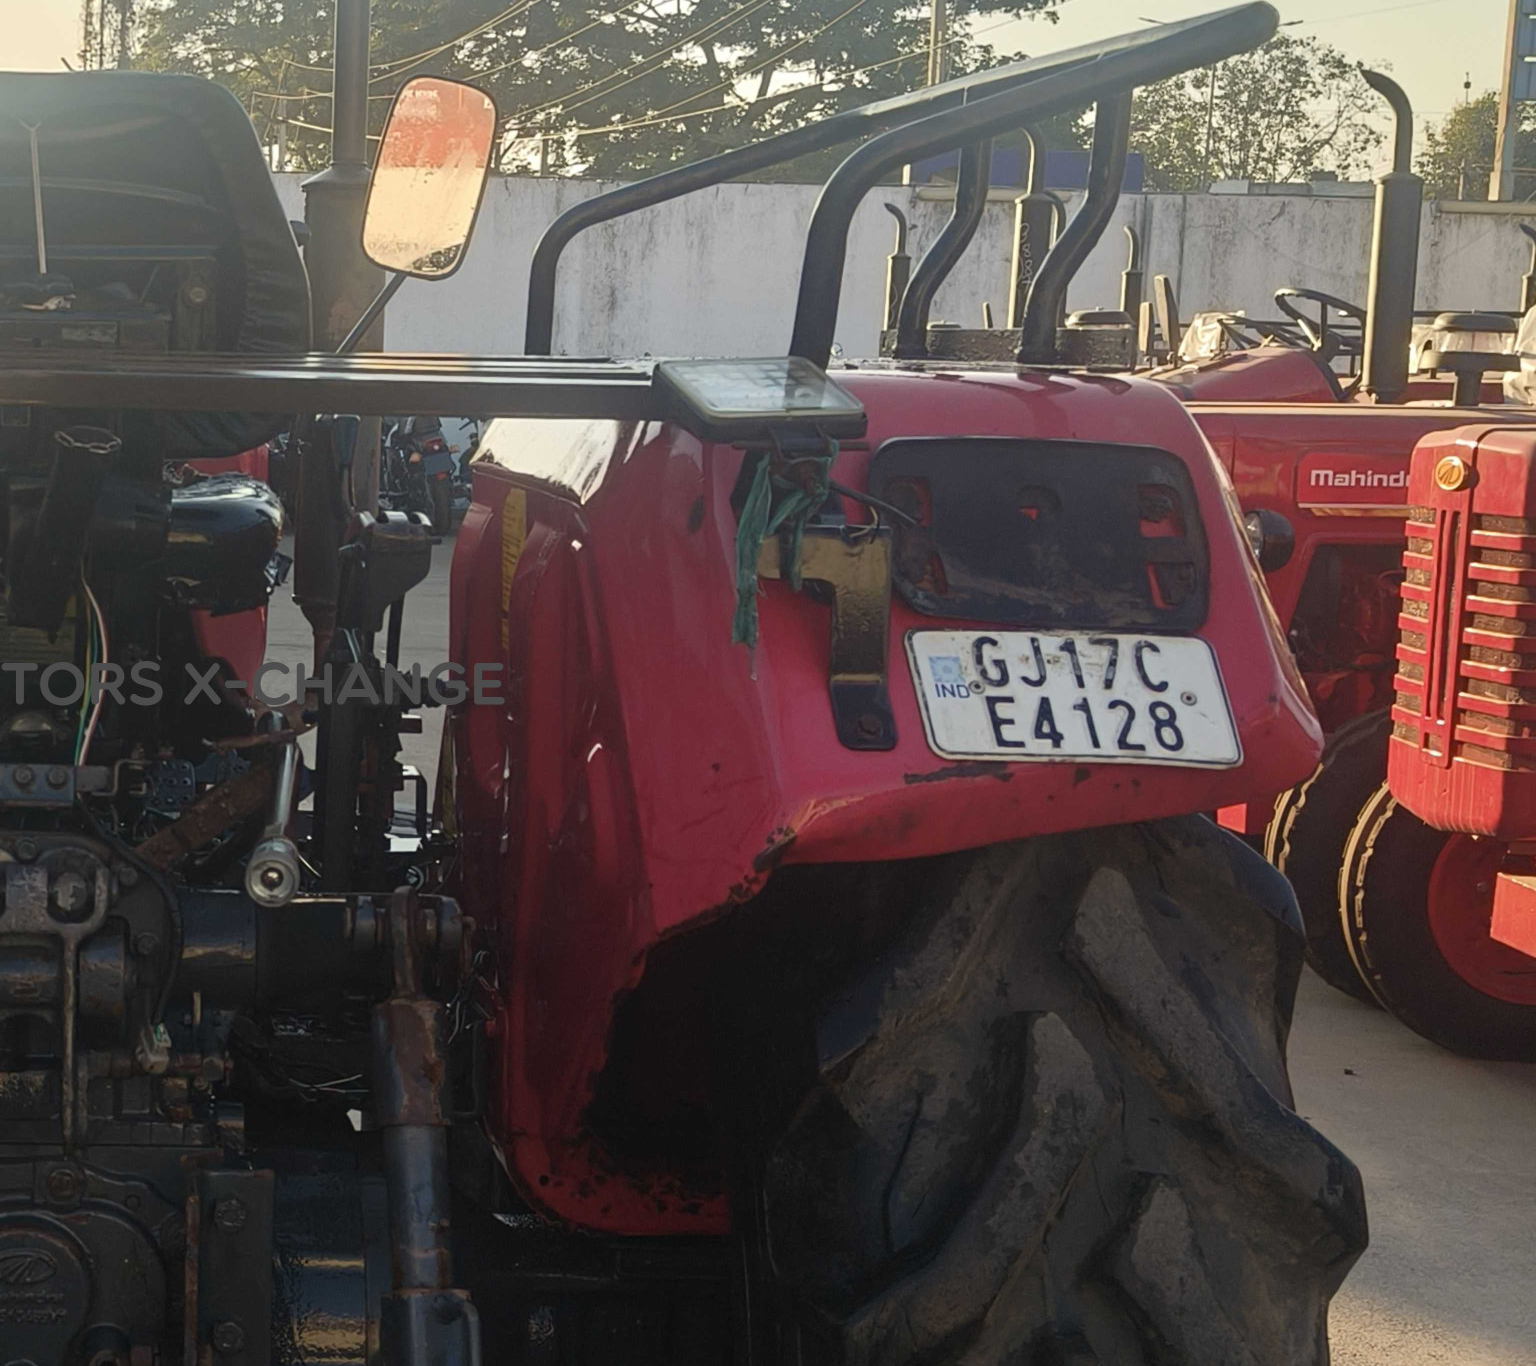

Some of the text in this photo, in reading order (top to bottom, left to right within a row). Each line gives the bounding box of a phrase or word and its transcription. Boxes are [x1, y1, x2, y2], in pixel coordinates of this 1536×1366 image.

[934, 683, 970, 699] IND
[971, 636, 1169, 693] GJ17C
[985, 696, 1184, 752] E4128
